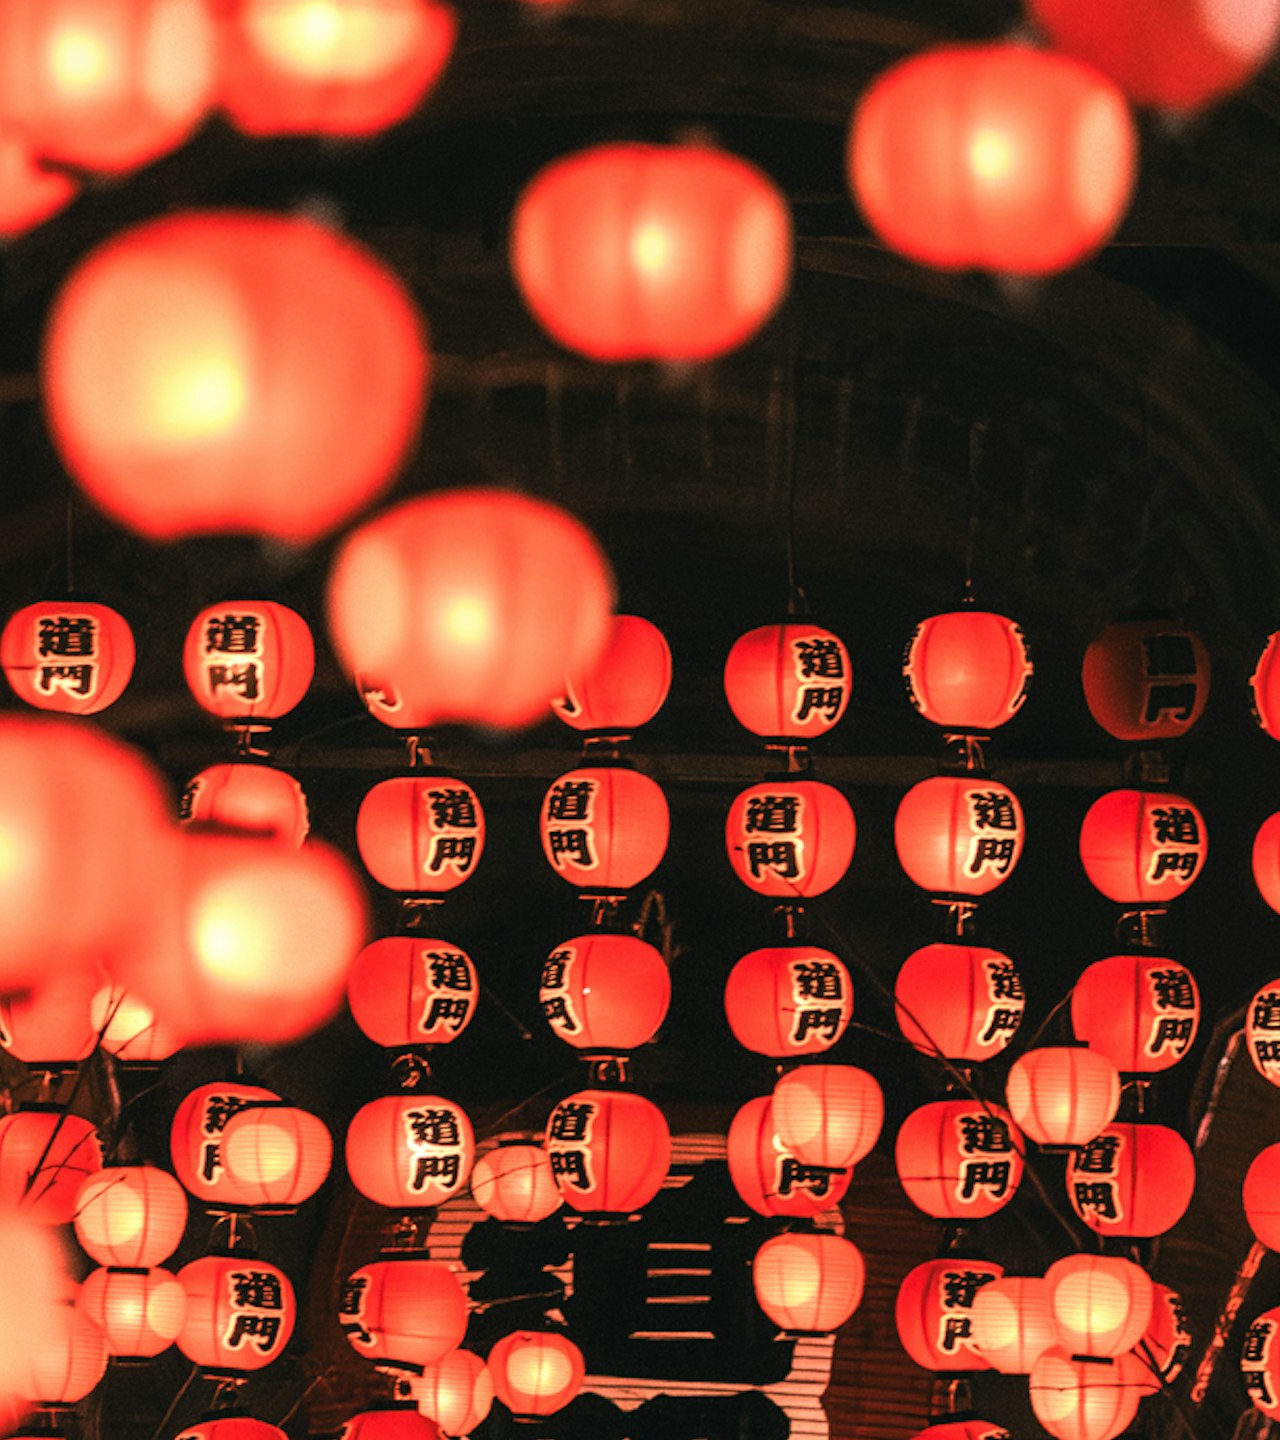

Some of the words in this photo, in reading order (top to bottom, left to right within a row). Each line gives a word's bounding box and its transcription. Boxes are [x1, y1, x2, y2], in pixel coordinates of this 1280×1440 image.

[39, 619, 95, 695] 道門
[206, 615, 261, 701] 道門
[795, 641, 840, 721] 道門
[429, 789, 475, 871] 道門
[548, 780, 595, 866] 道門
[745, 796, 800, 879] 道門
[970, 793, 1016, 877] 道門
[1151, 808, 1199, 881] 道門
[423, 951, 471, 1031] 道門
[794, 963, 841, 1042] 道門
[1149, 970, 1195, 1056] 道門
[408, 1109, 459, 1190] 道門
[550, 1104, 595, 1190] 道門
[961, 1116, 1012, 1199] 道門
[1073, 1136, 1121, 1220] 道門
[231, 1271, 282, 1351] 道門
